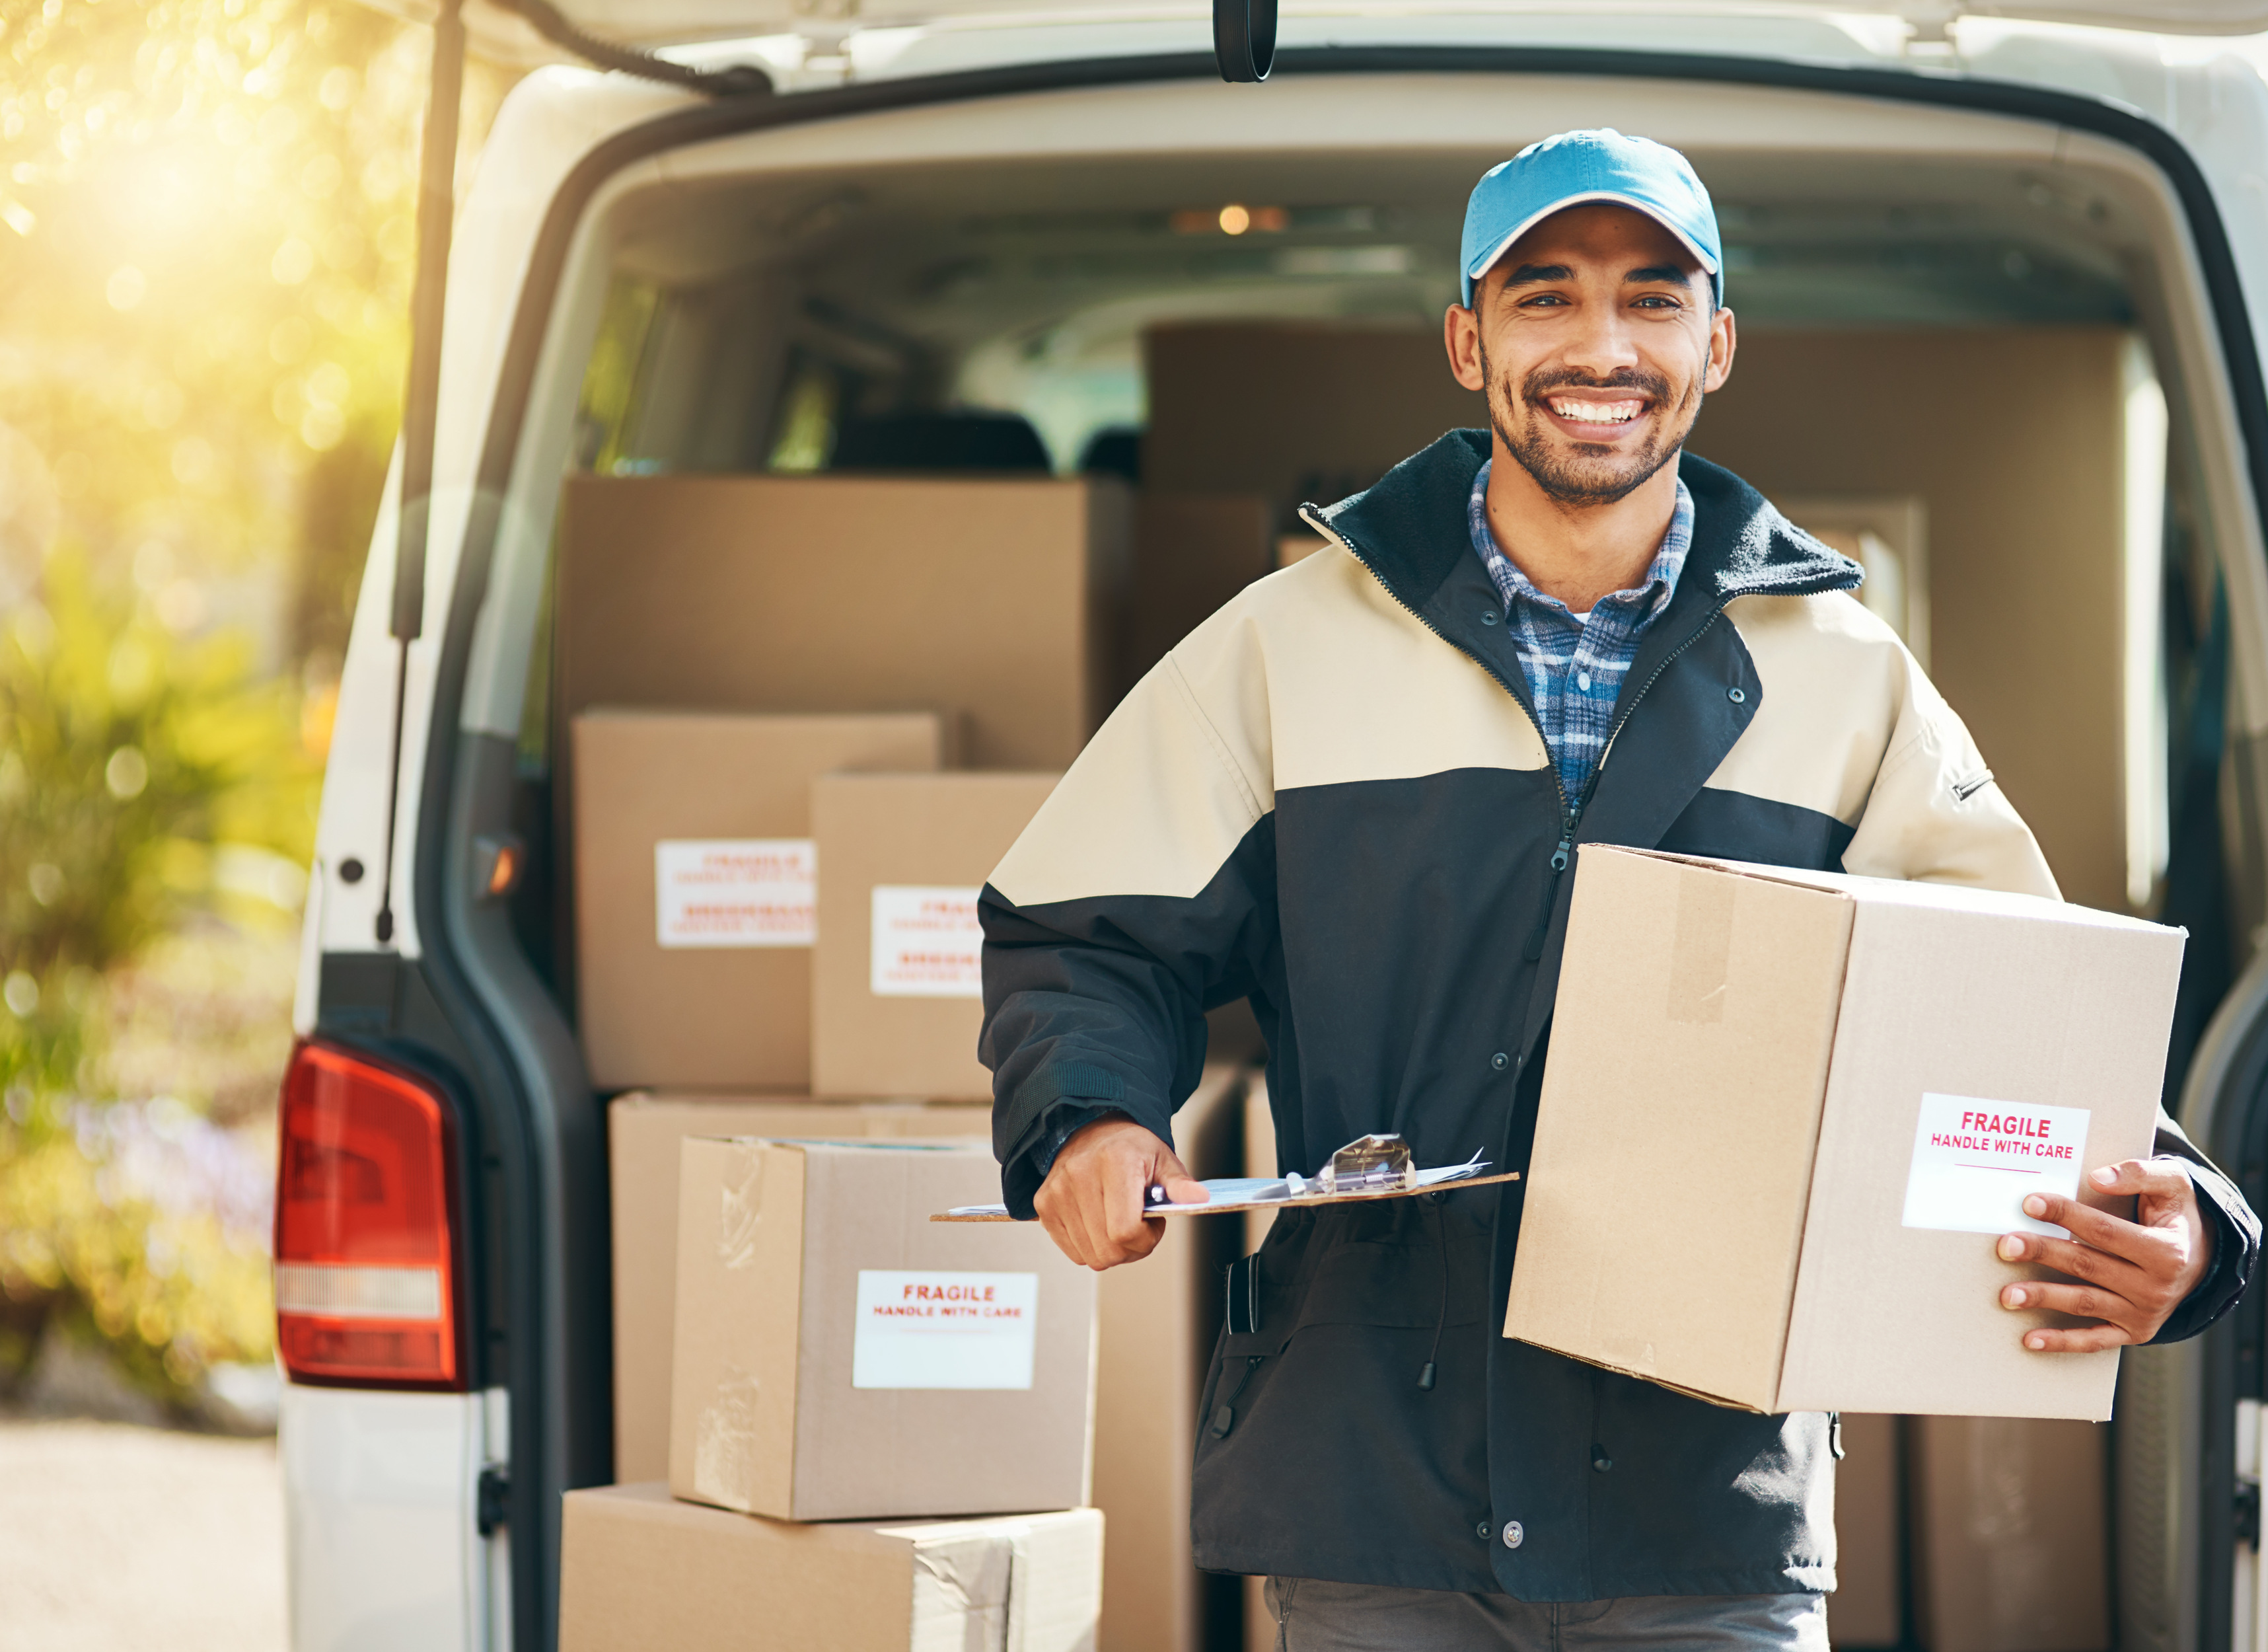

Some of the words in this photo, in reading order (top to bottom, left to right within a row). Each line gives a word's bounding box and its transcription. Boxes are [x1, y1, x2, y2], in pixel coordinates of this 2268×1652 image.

[1961, 1111, 2051, 1139] FRAGILE
[1931, 1133, 1990, 1151] HANDLE
[1994, 1139, 2031, 1155] WITH
[2035, 1143, 2074, 1159] CARE
[903, 1284, 995, 1302] FRAGILE
[873, 1305, 934, 1317] HANDLE
[940, 1306, 978, 1318] WITH
[983, 1306, 1023, 1318] CARE
